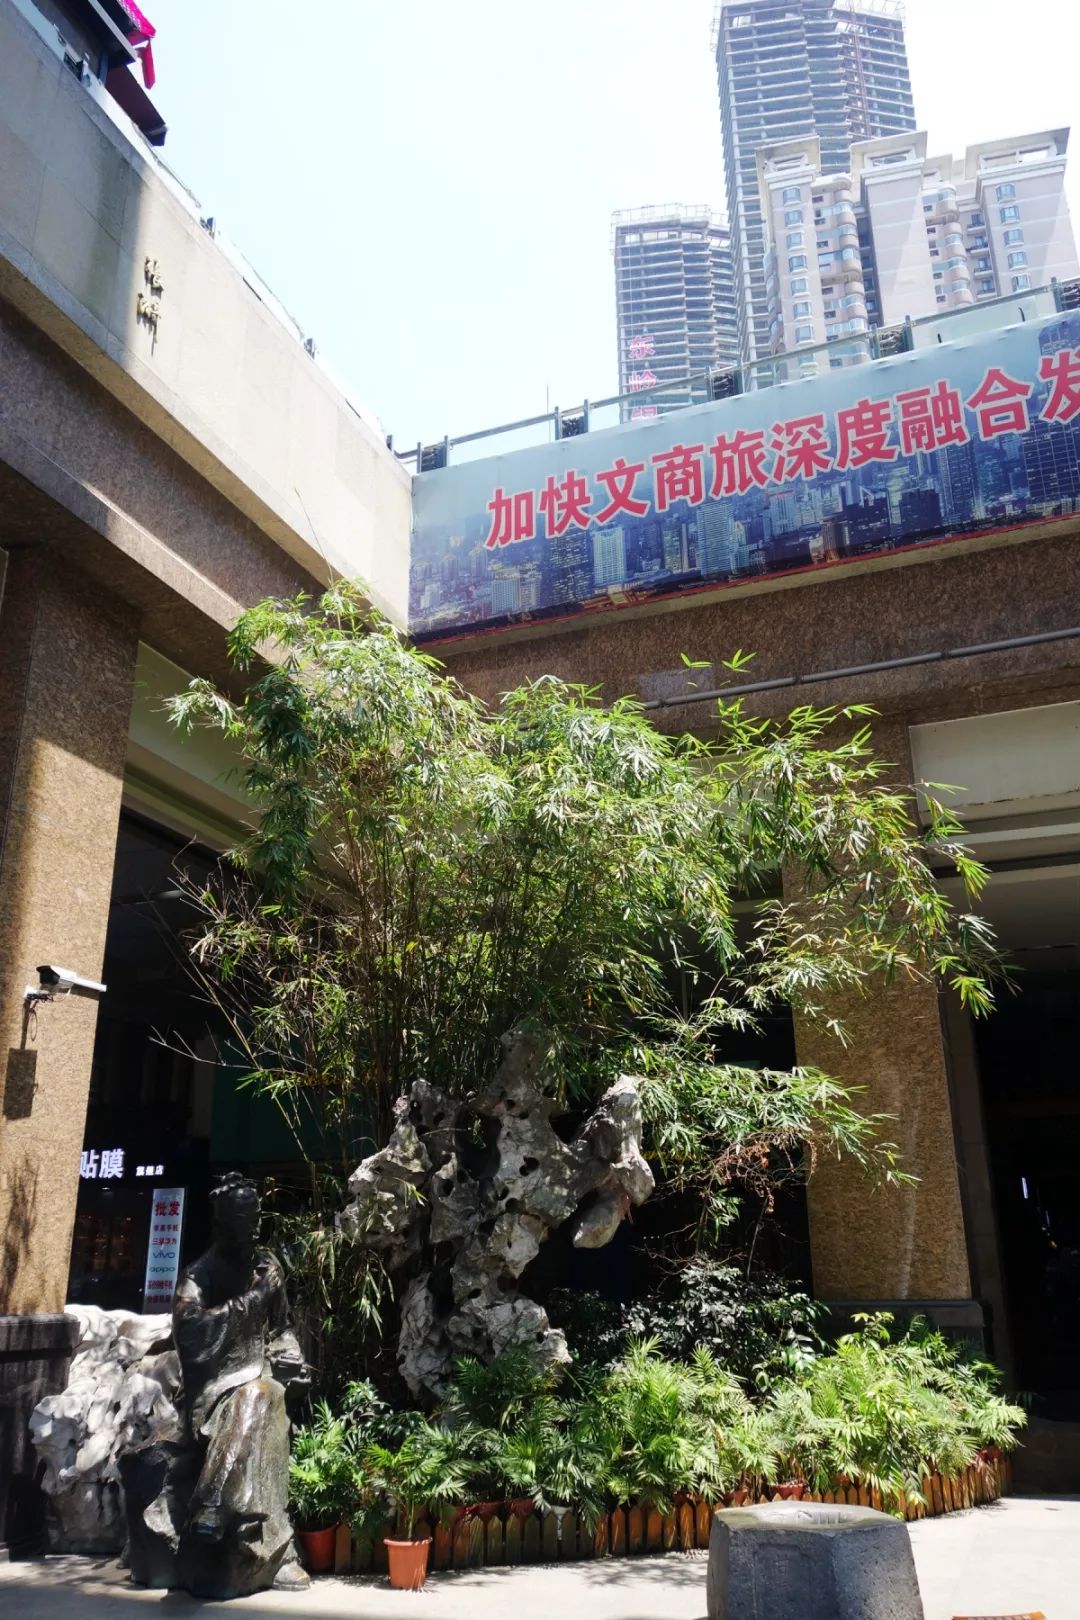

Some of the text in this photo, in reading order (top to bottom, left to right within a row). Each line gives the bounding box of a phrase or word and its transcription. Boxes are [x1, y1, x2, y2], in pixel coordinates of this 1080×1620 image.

[484, 347, 1080, 549] 加快文商旅深度融合发
[80, 1148, 125, 1179] 贴膜
[154, 1199, 180, 1217] 批发
[153, 1250, 175, 1258] vivo
